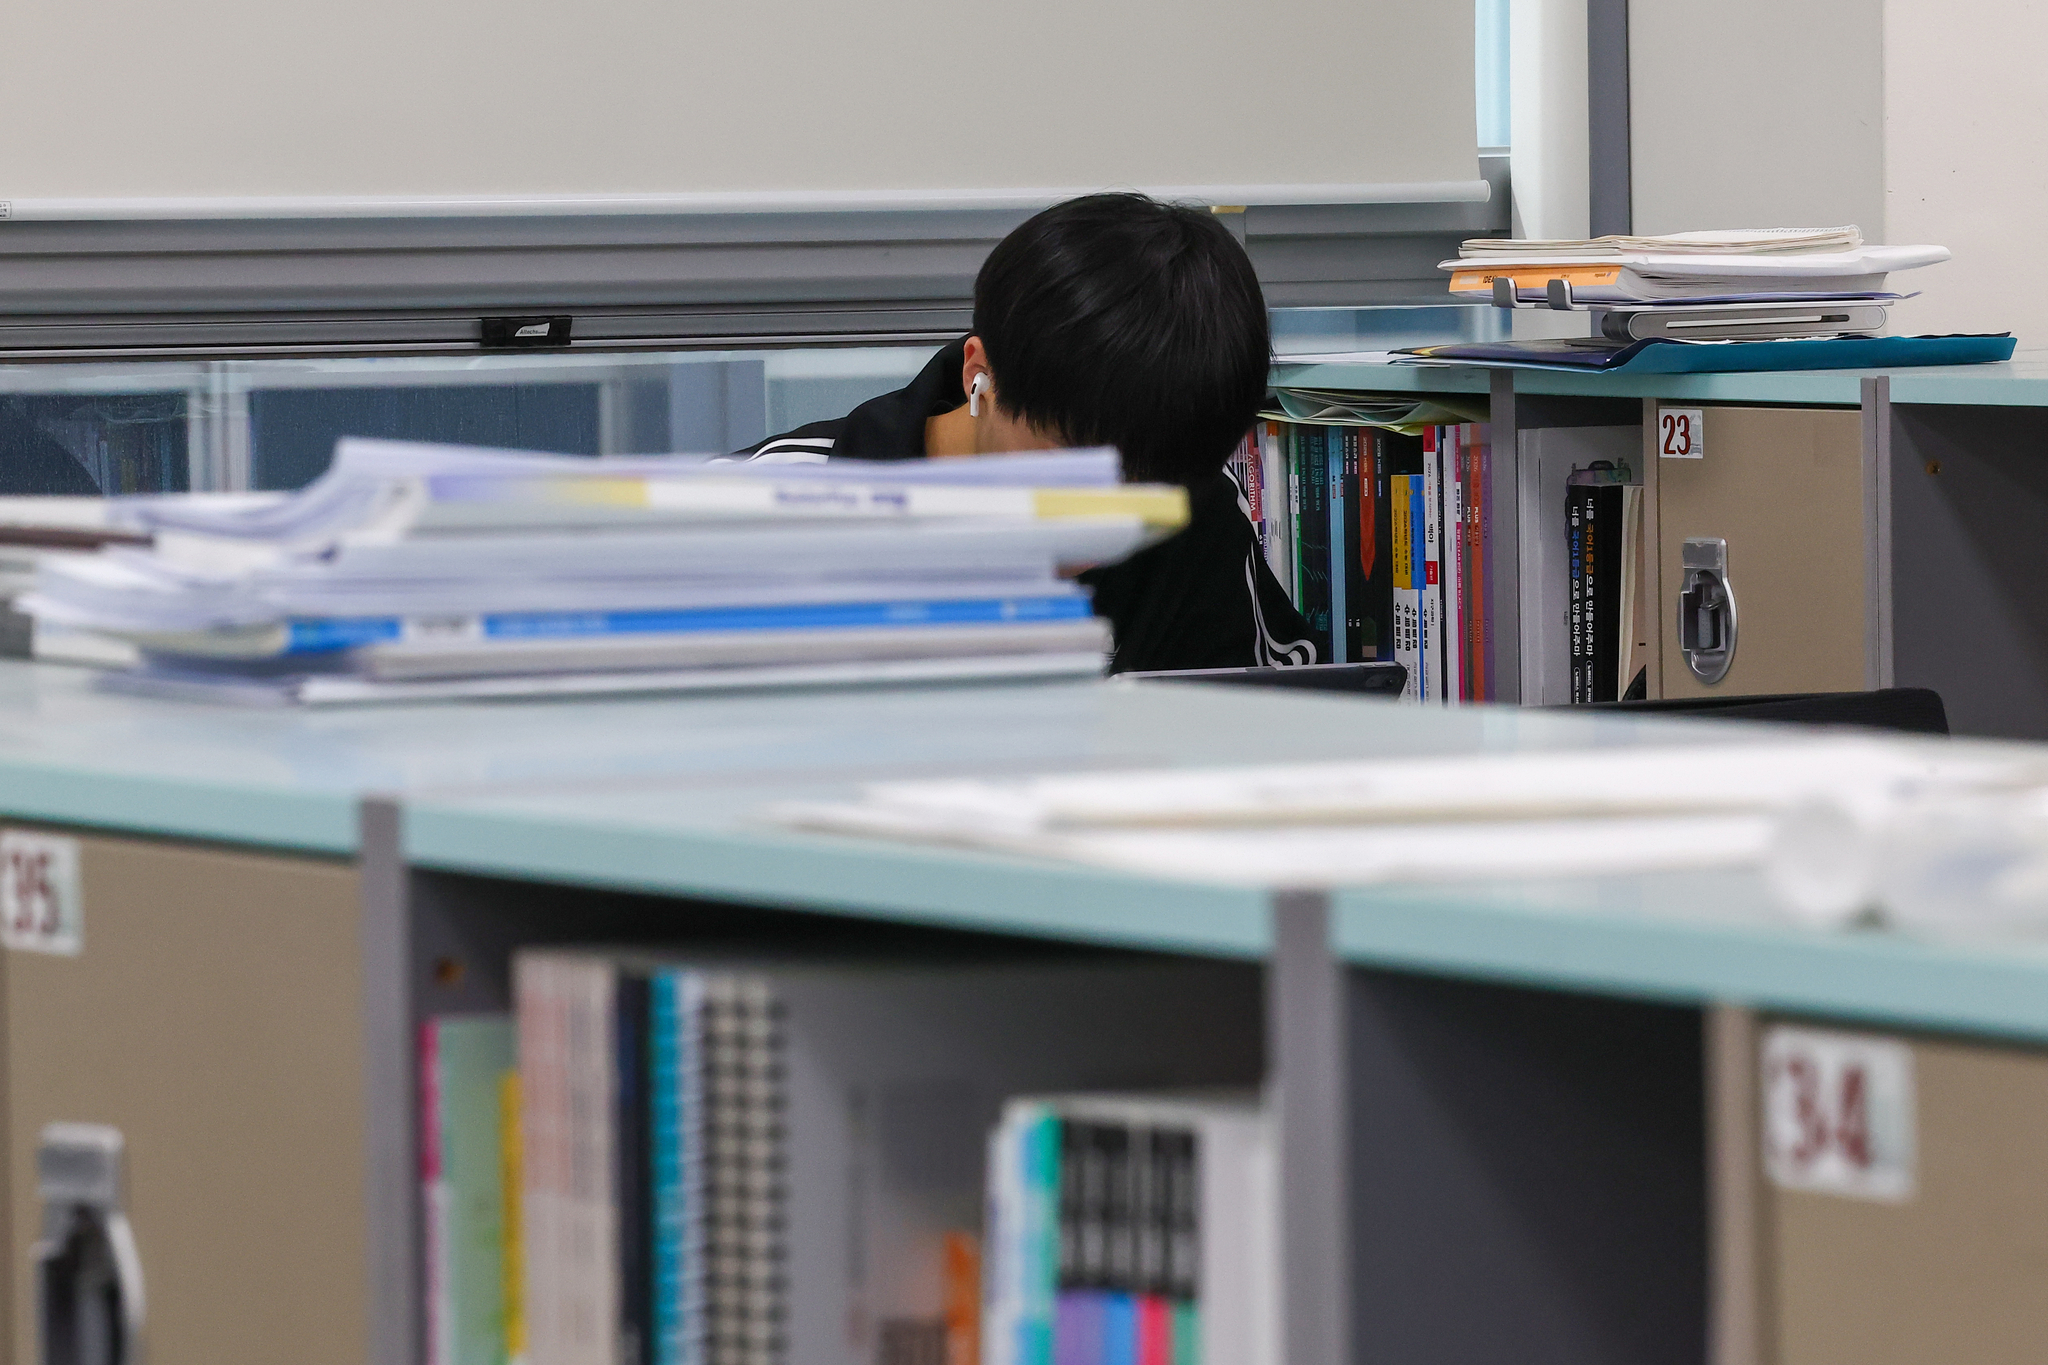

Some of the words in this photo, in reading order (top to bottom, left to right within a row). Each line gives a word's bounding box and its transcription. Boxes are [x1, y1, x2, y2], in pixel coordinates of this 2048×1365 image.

[1663, 414, 1691, 455] 23
[1248, 454, 1256, 511] ALGORITHM
[1572, 506, 1580, 527] 너를
[1586, 498, 1594, 520] 너를
[1572, 603, 1581, 656] 만들어주마
[1586, 600, 1594, 656] 만들어주마
